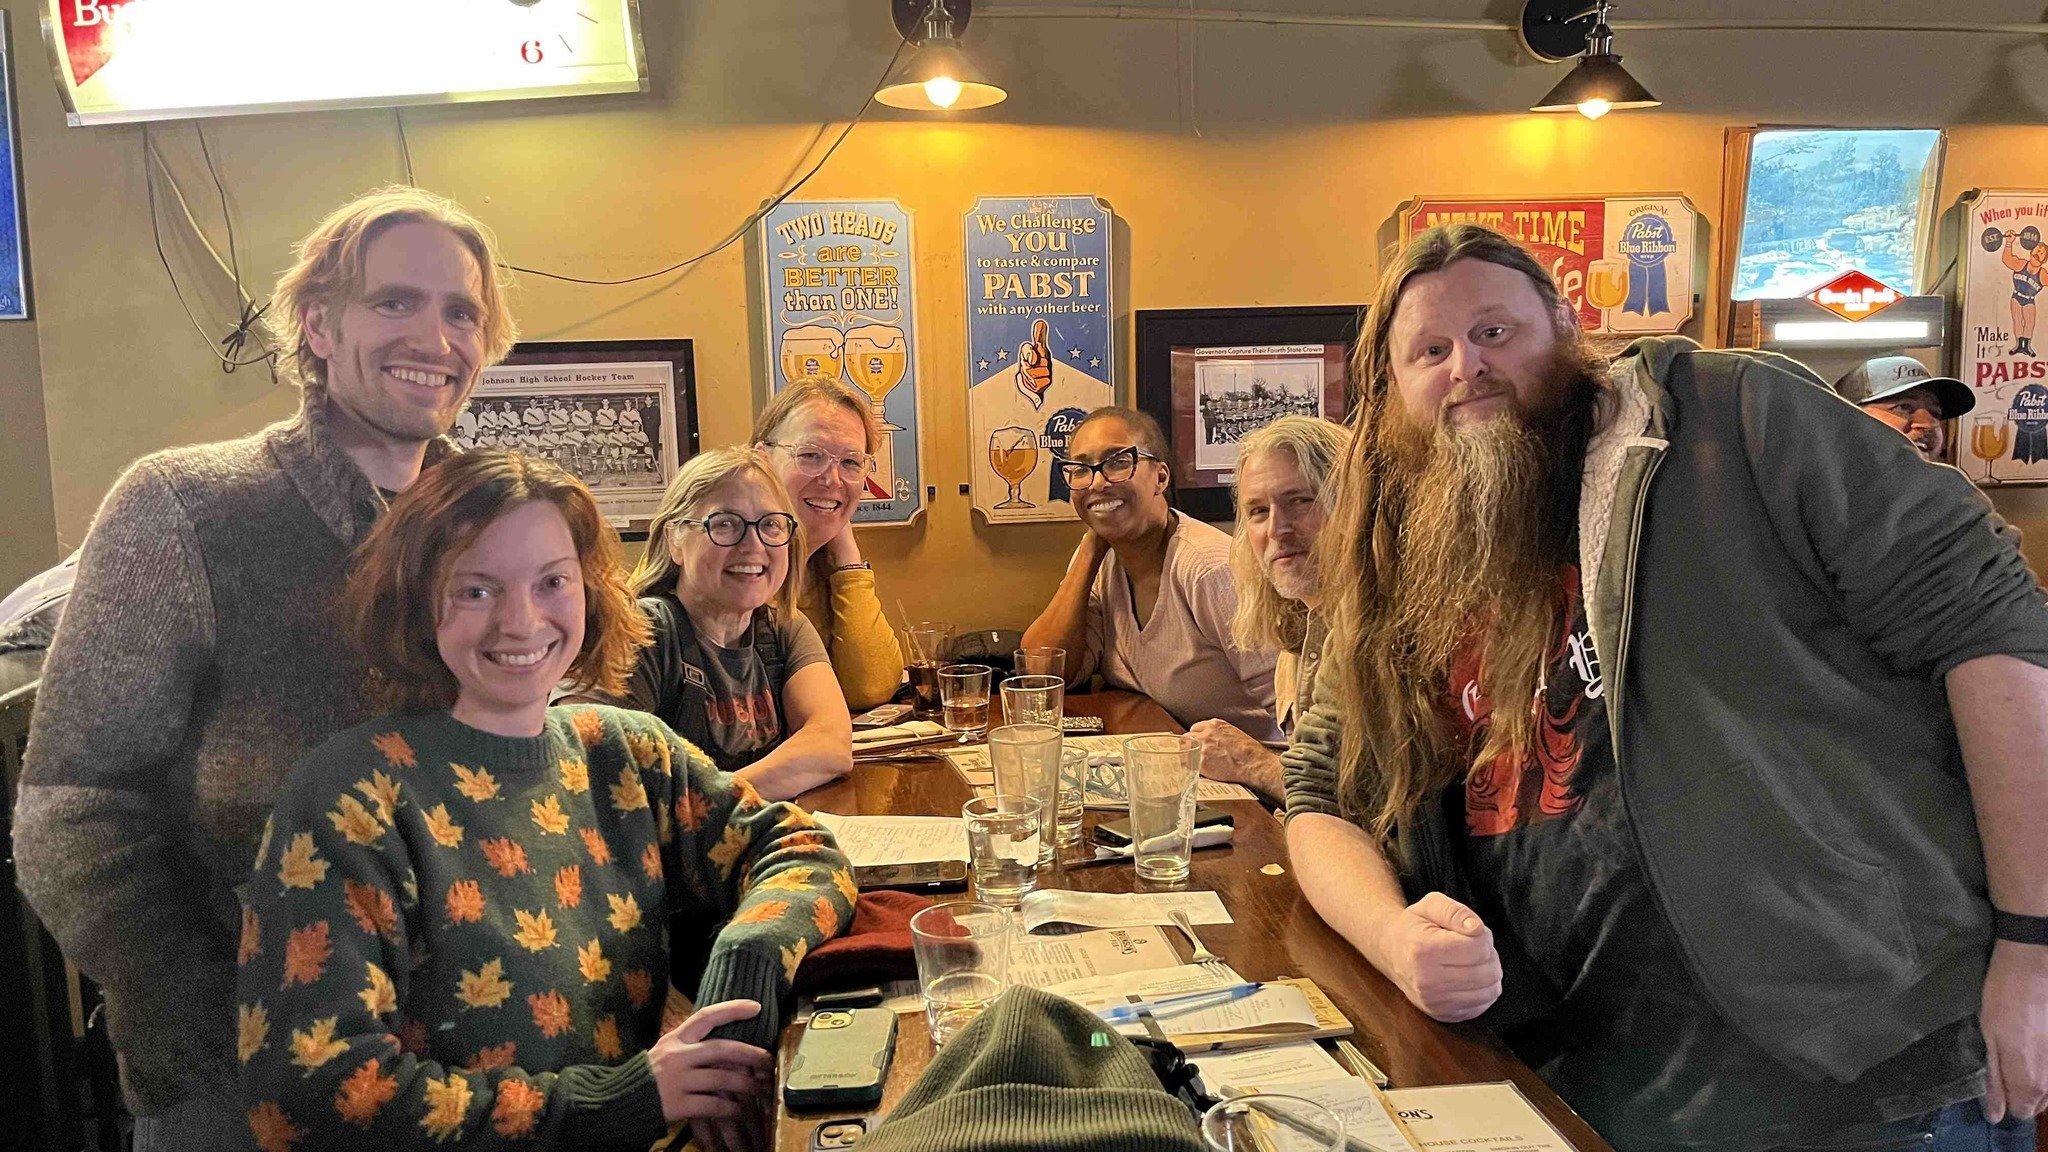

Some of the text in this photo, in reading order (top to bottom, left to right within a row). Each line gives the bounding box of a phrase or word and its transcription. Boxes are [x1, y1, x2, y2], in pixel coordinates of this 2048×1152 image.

[521, 40, 543, 64] 6
[1628, 204, 1670, 217] ORIGINAL
[1980, 207, 2012, 225] When
[2015, 206, 2033, 220] you
[775, 211, 897, 245] TWO HEADS
[976, 213, 1096, 236] We Challenge
[1513, 210, 1586, 256] TIME
[1631, 222, 1664, 239] Pabst
[1004, 231, 1069, 253] YOU
[1619, 241, 1676, 253] Blue Ribbon
[817, 245, 862, 262] are
[976, 255, 1100, 271] to taste & compare
[782, 266, 900, 287] BETTER
[982, 271, 1096, 299] PABST
[784, 287, 898, 311] than ONE!
[977, 300, 1101, 319] with any other beer
[1228, 347, 1252, 355] Capture
[482, 377, 515, 386] Johnson
[520, 376, 539, 384] High
[544, 375, 571, 383] School
[576, 374, 607, 382] Hockey
[1975, 361, 2048, 387] PABS
[2019, 391, 2047, 406] Pabst
[1053, 414, 1084, 433] Pab
[2008, 409, 2026, 420] Blue
[1040, 435, 1064, 448] Blue
[1418, 1135, 1524, 1148] HOUSE COCKTAILS
